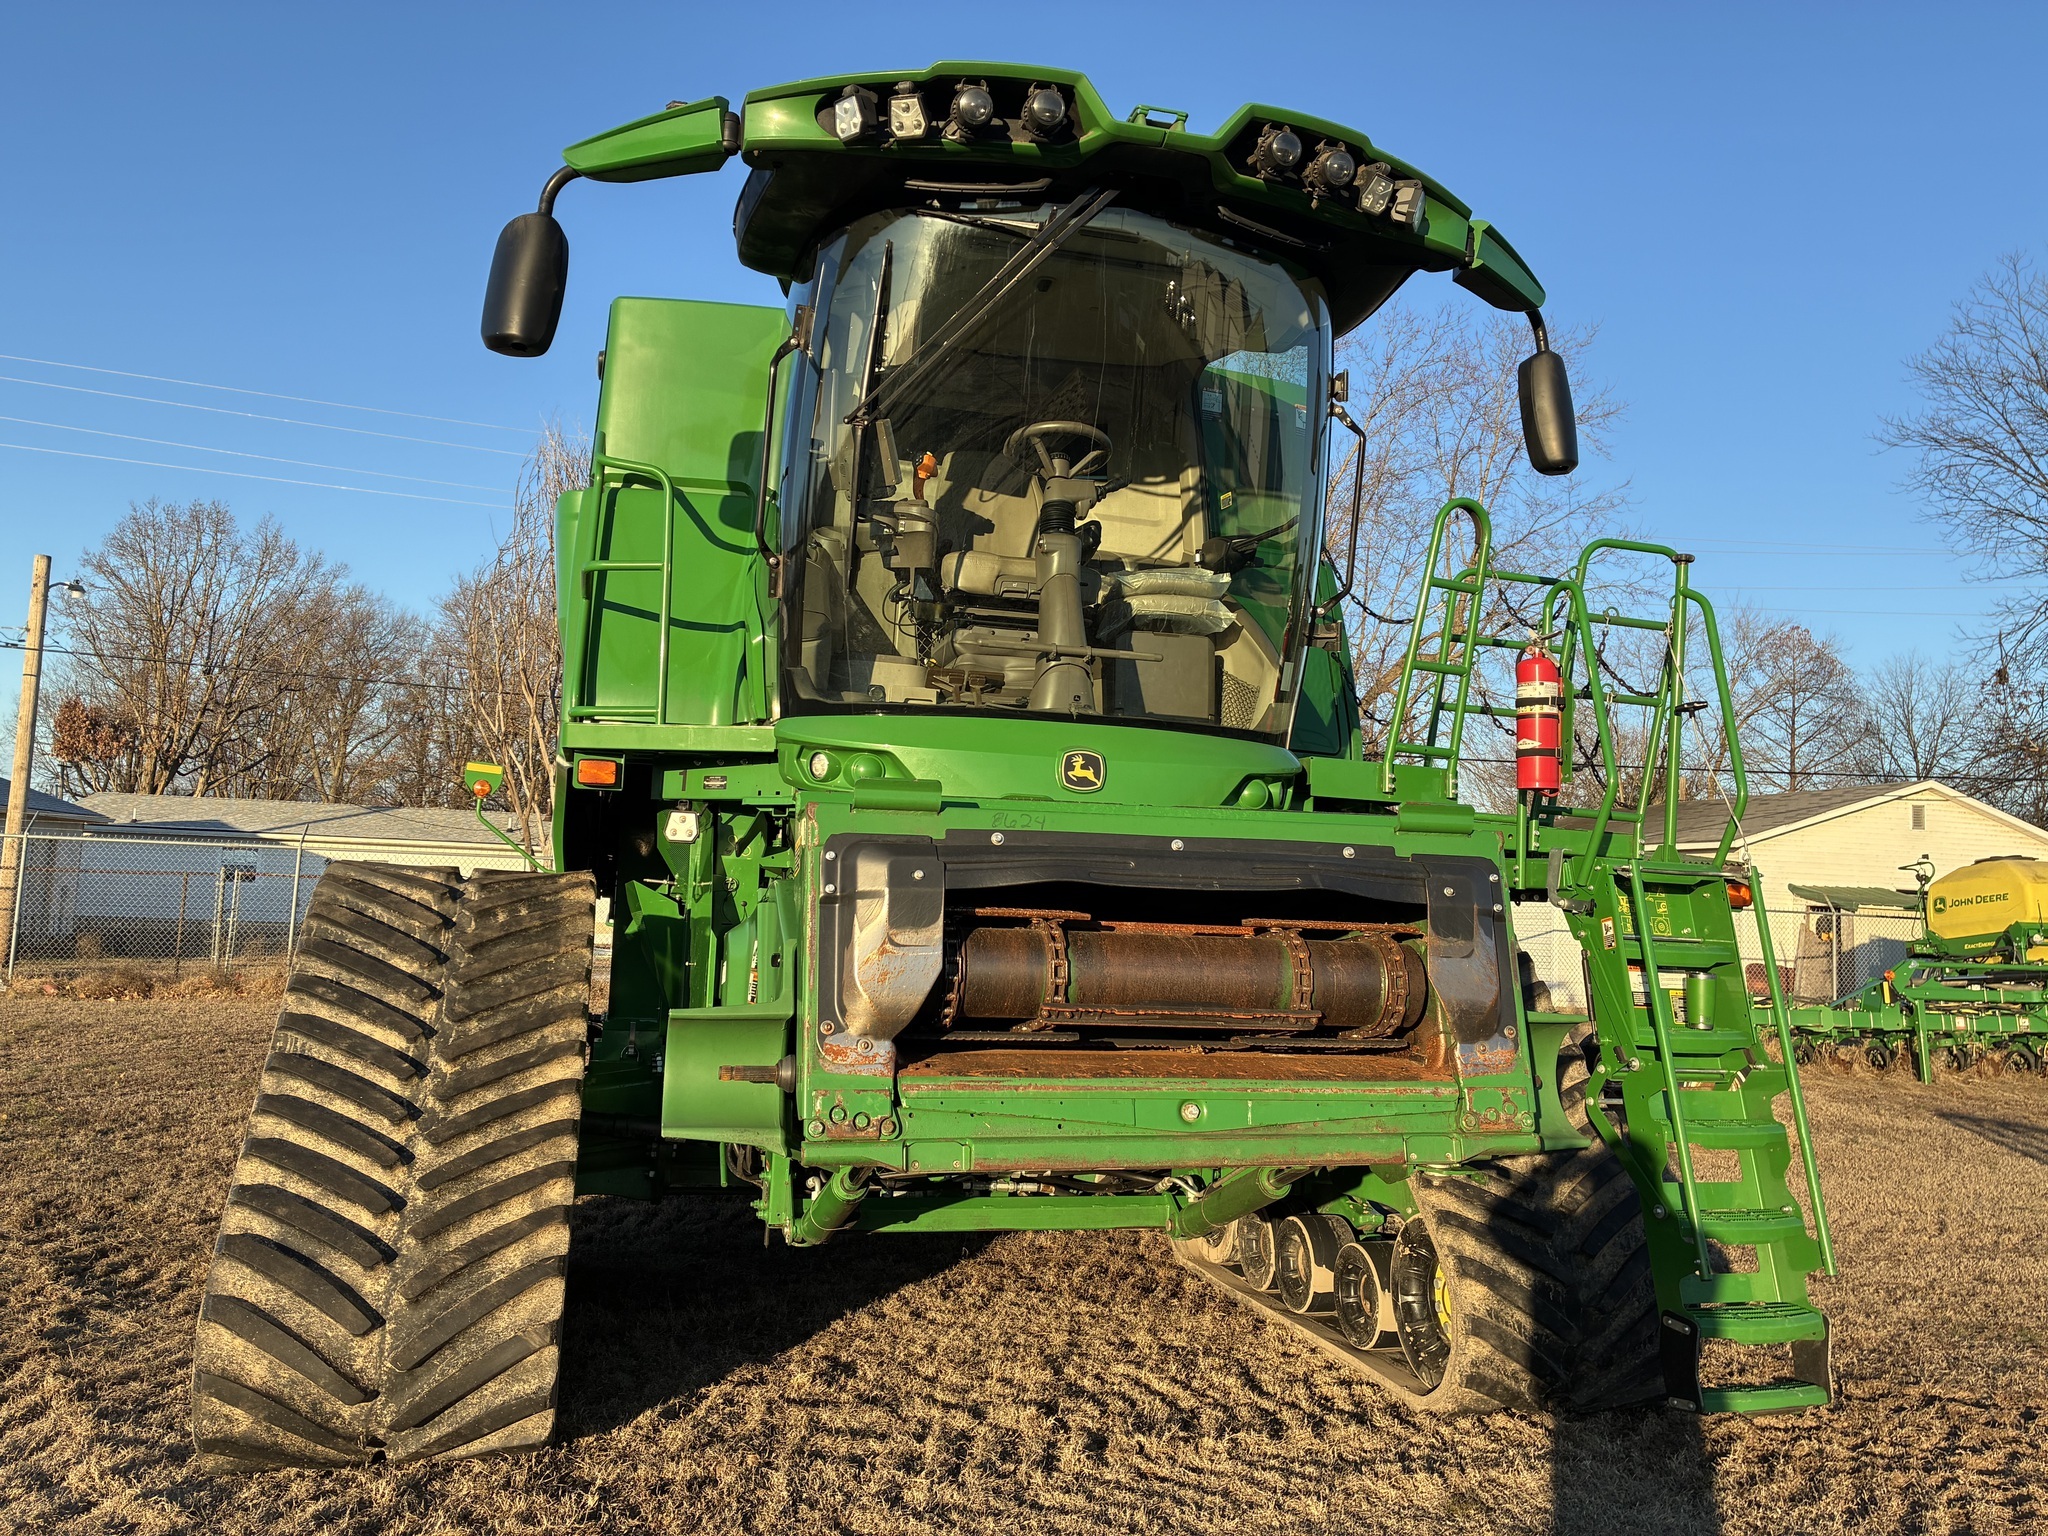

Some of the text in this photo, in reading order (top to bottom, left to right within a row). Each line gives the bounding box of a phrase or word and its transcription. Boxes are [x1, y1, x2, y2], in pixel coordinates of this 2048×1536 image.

[679, 769, 687, 791] 1
[1949, 893, 2009, 908] JOHN DEERE
